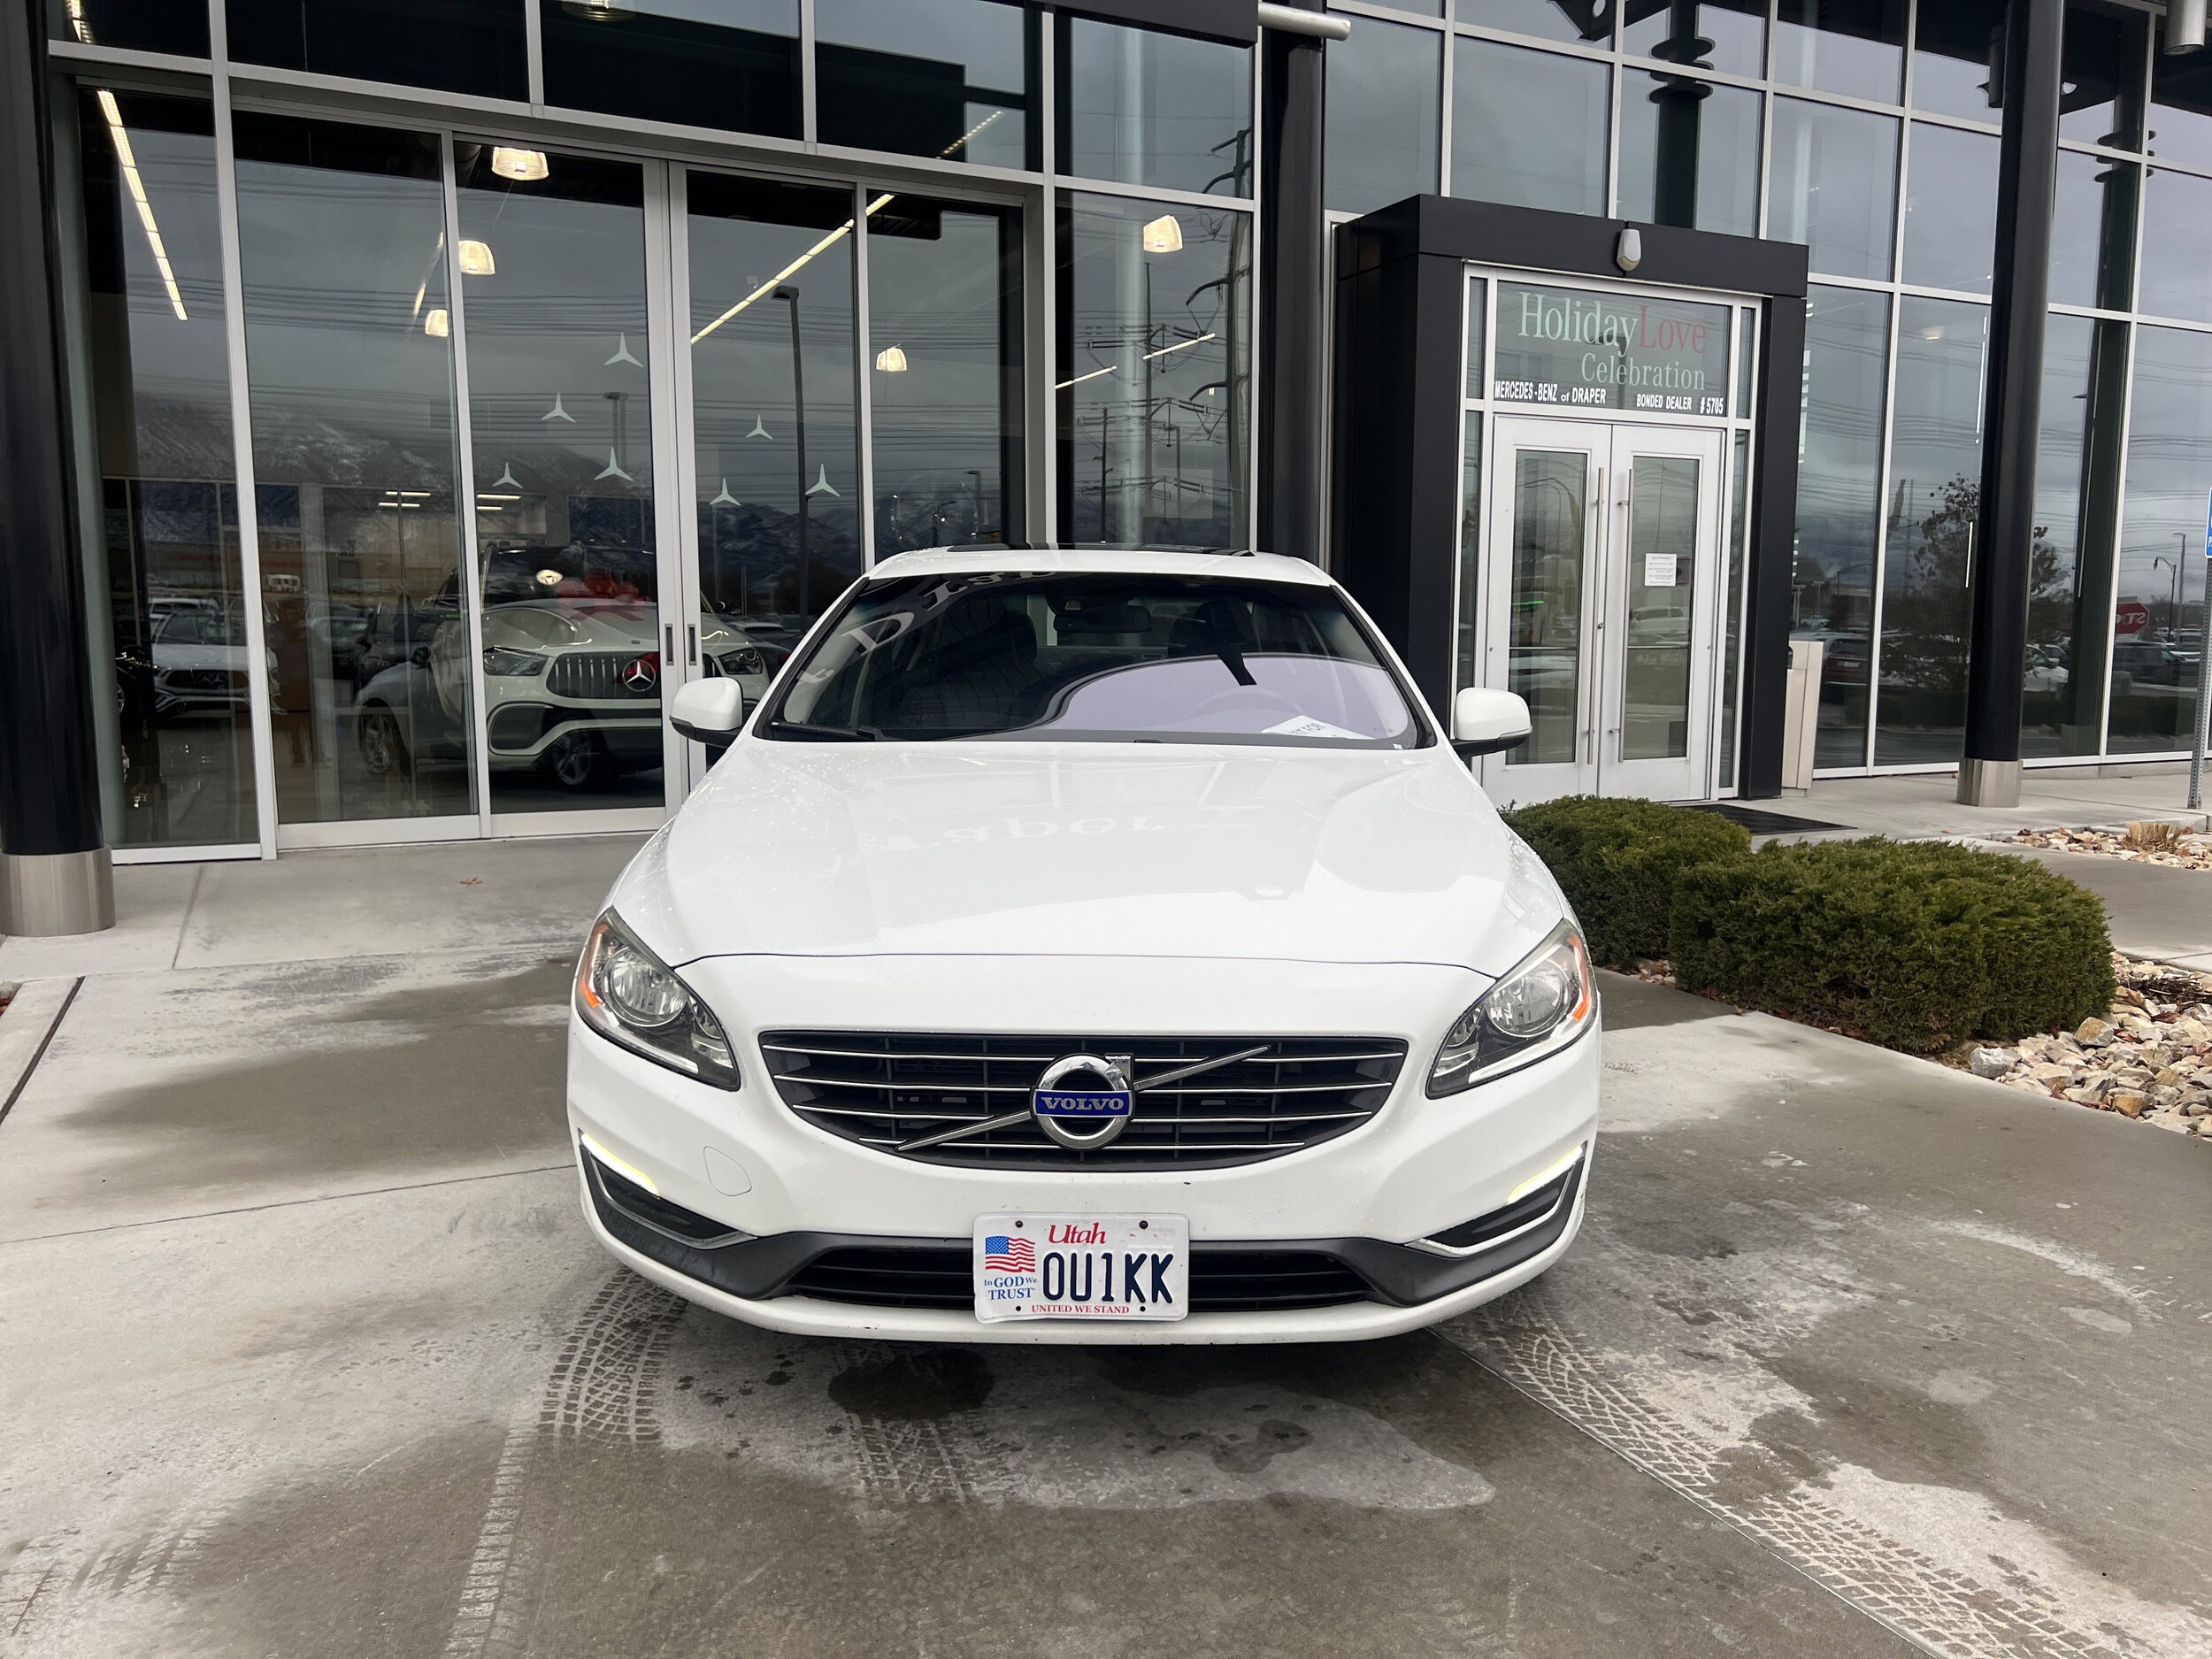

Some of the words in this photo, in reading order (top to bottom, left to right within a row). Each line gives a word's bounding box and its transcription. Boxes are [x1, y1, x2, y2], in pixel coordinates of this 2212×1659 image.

[1581, 352, 1705, 390] Celebration
[1560, 392, 1571, 402] of
[1571, 387, 1607, 404] DRAPER
[1636, 394, 1663, 409] BONDED
[1665, 396, 1693, 411] DEALER
[1041, 1097, 1124, 1110] VOLVO
[1048, 1222, 1106, 1245] Utah
[994, 1276, 1024, 1288] GOD
[988, 1288, 1034, 1300] TRUST
[1032, 1304, 1072, 1313] UNITED
[1094, 1305, 1130, 1314] STAND
